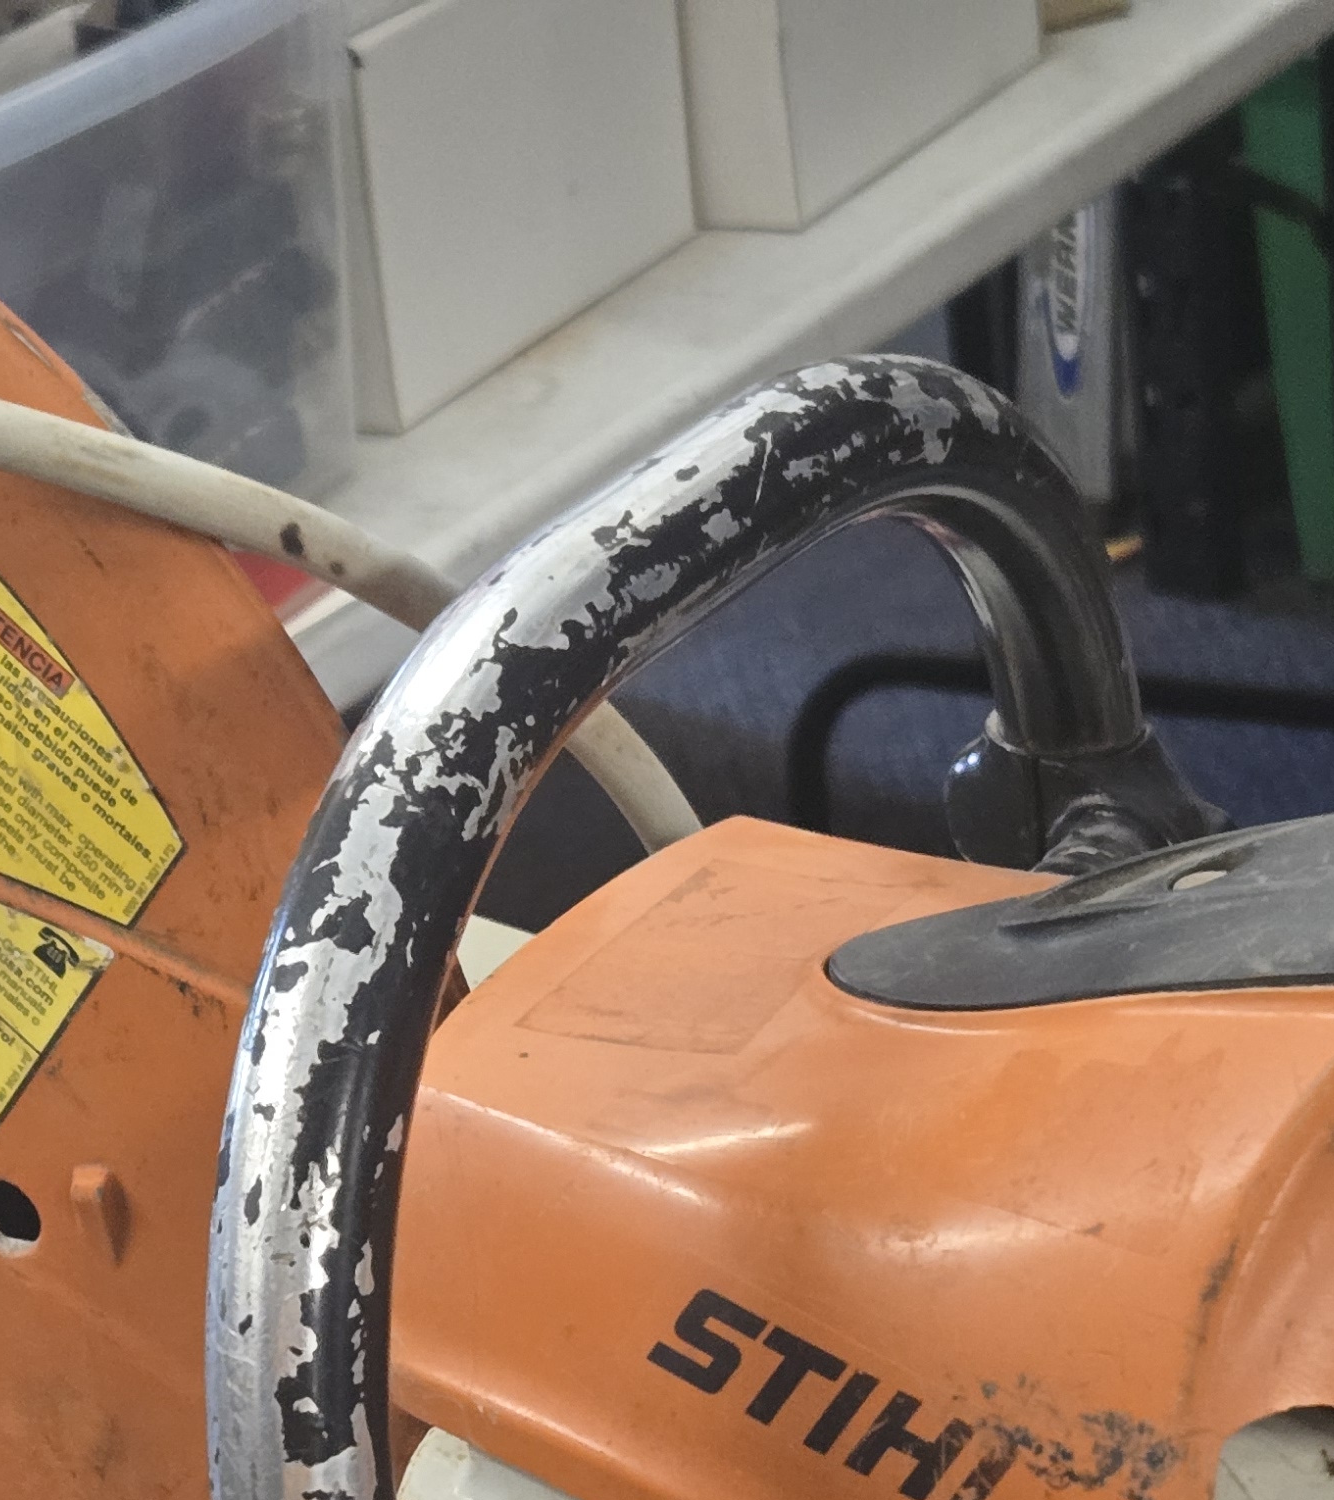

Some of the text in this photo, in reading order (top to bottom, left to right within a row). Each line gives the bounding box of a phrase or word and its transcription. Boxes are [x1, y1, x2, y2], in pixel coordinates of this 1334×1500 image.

[0, 653, 23, 679] las
[14, 708, 75, 768] indebido
[72, 764, 118, 811] puede
[31, 707, 51, 727] en
[51, 723, 68, 742] el
[67, 737, 120, 789] manual
[118, 785, 139, 808] de
[15, 793, 99, 874] diameter 350
[30, 747, 79, 795] graves
[79, 791, 91, 804] o
[91, 800, 156, 864] mortales.
[11, 810, 43, 844] only
[38, 836, 107, 904] composite
[25, 841, 59, 876] must
[57, 871, 78, 893] be
[74, 831, 138, 894] operating
